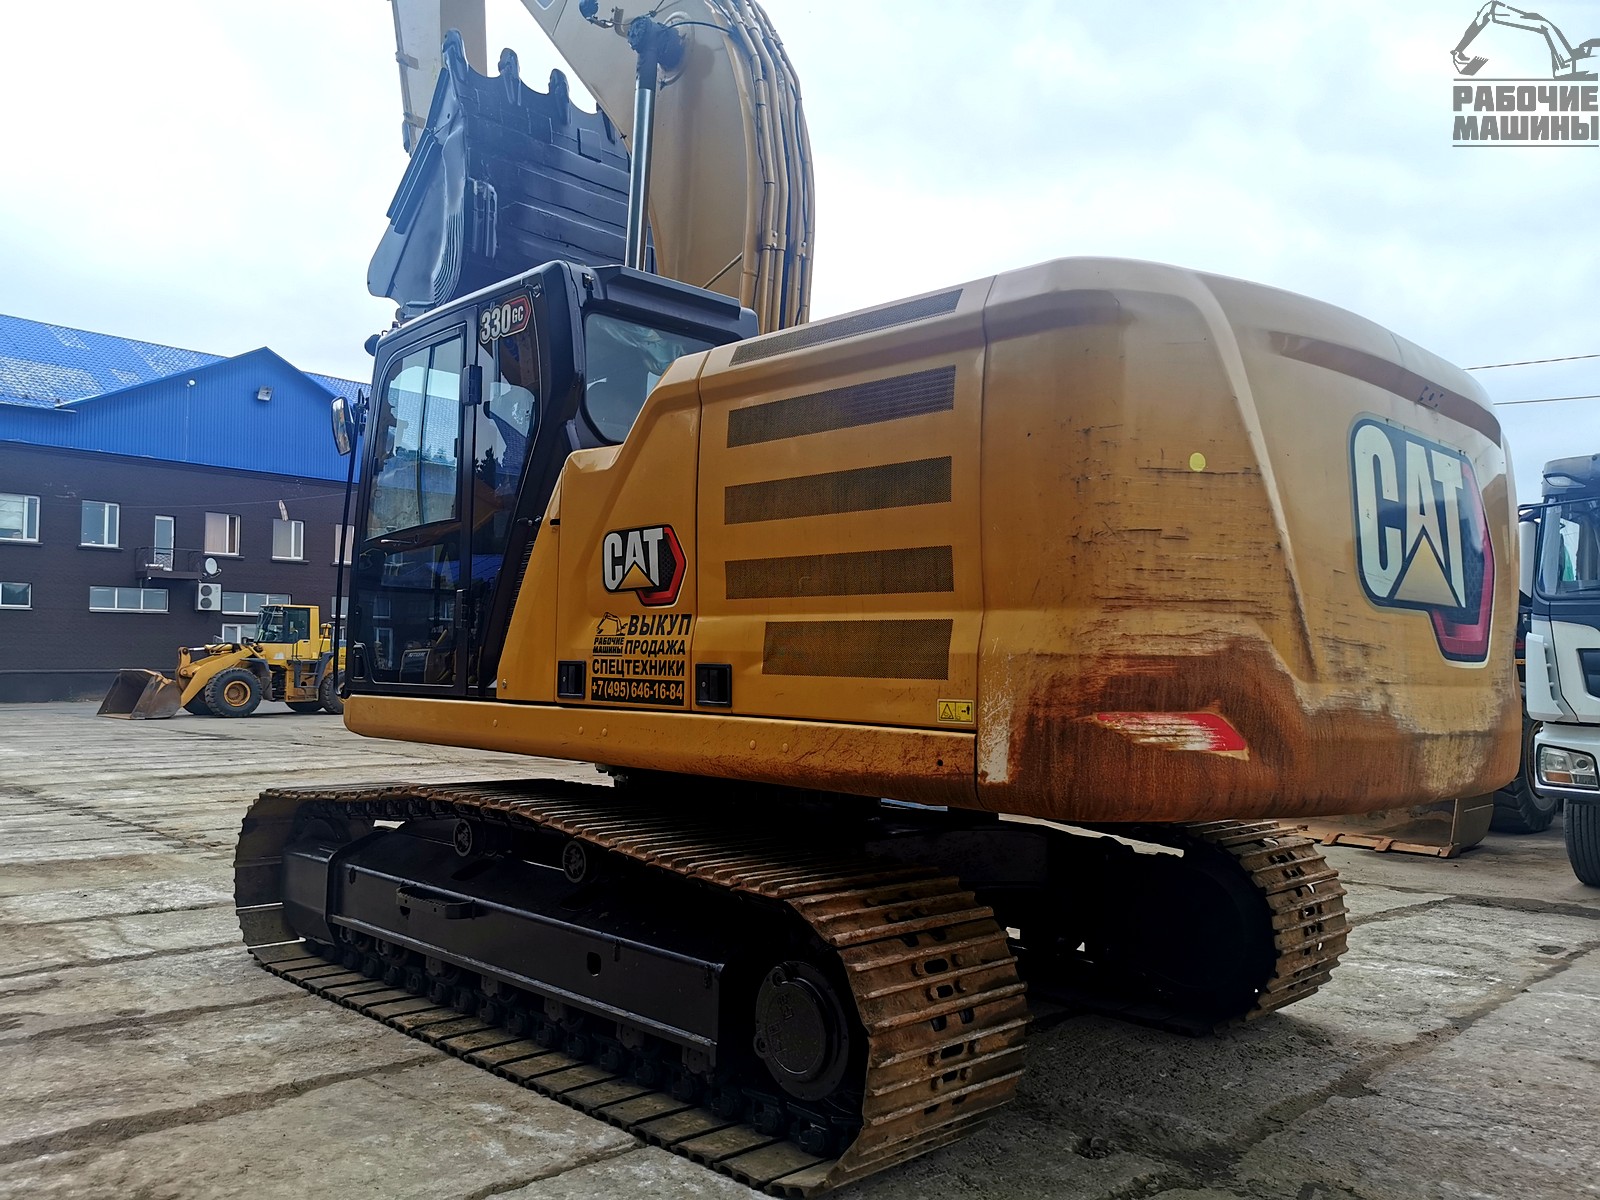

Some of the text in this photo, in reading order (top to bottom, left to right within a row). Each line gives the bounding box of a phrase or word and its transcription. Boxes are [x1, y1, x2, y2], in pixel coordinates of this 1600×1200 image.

[1354, 424, 1466, 608] CAT
[603, 527, 664, 591] CAT
[627, 613, 692, 636] ВЫКУП
[592, 646, 623, 654] МАШИНЫ
[594, 637, 625, 646] РАБОЧИЕ
[624, 639, 686, 658] ПРОДАЖА
[592, 658, 685, 678] СПЕЦТЕХНИКИ
